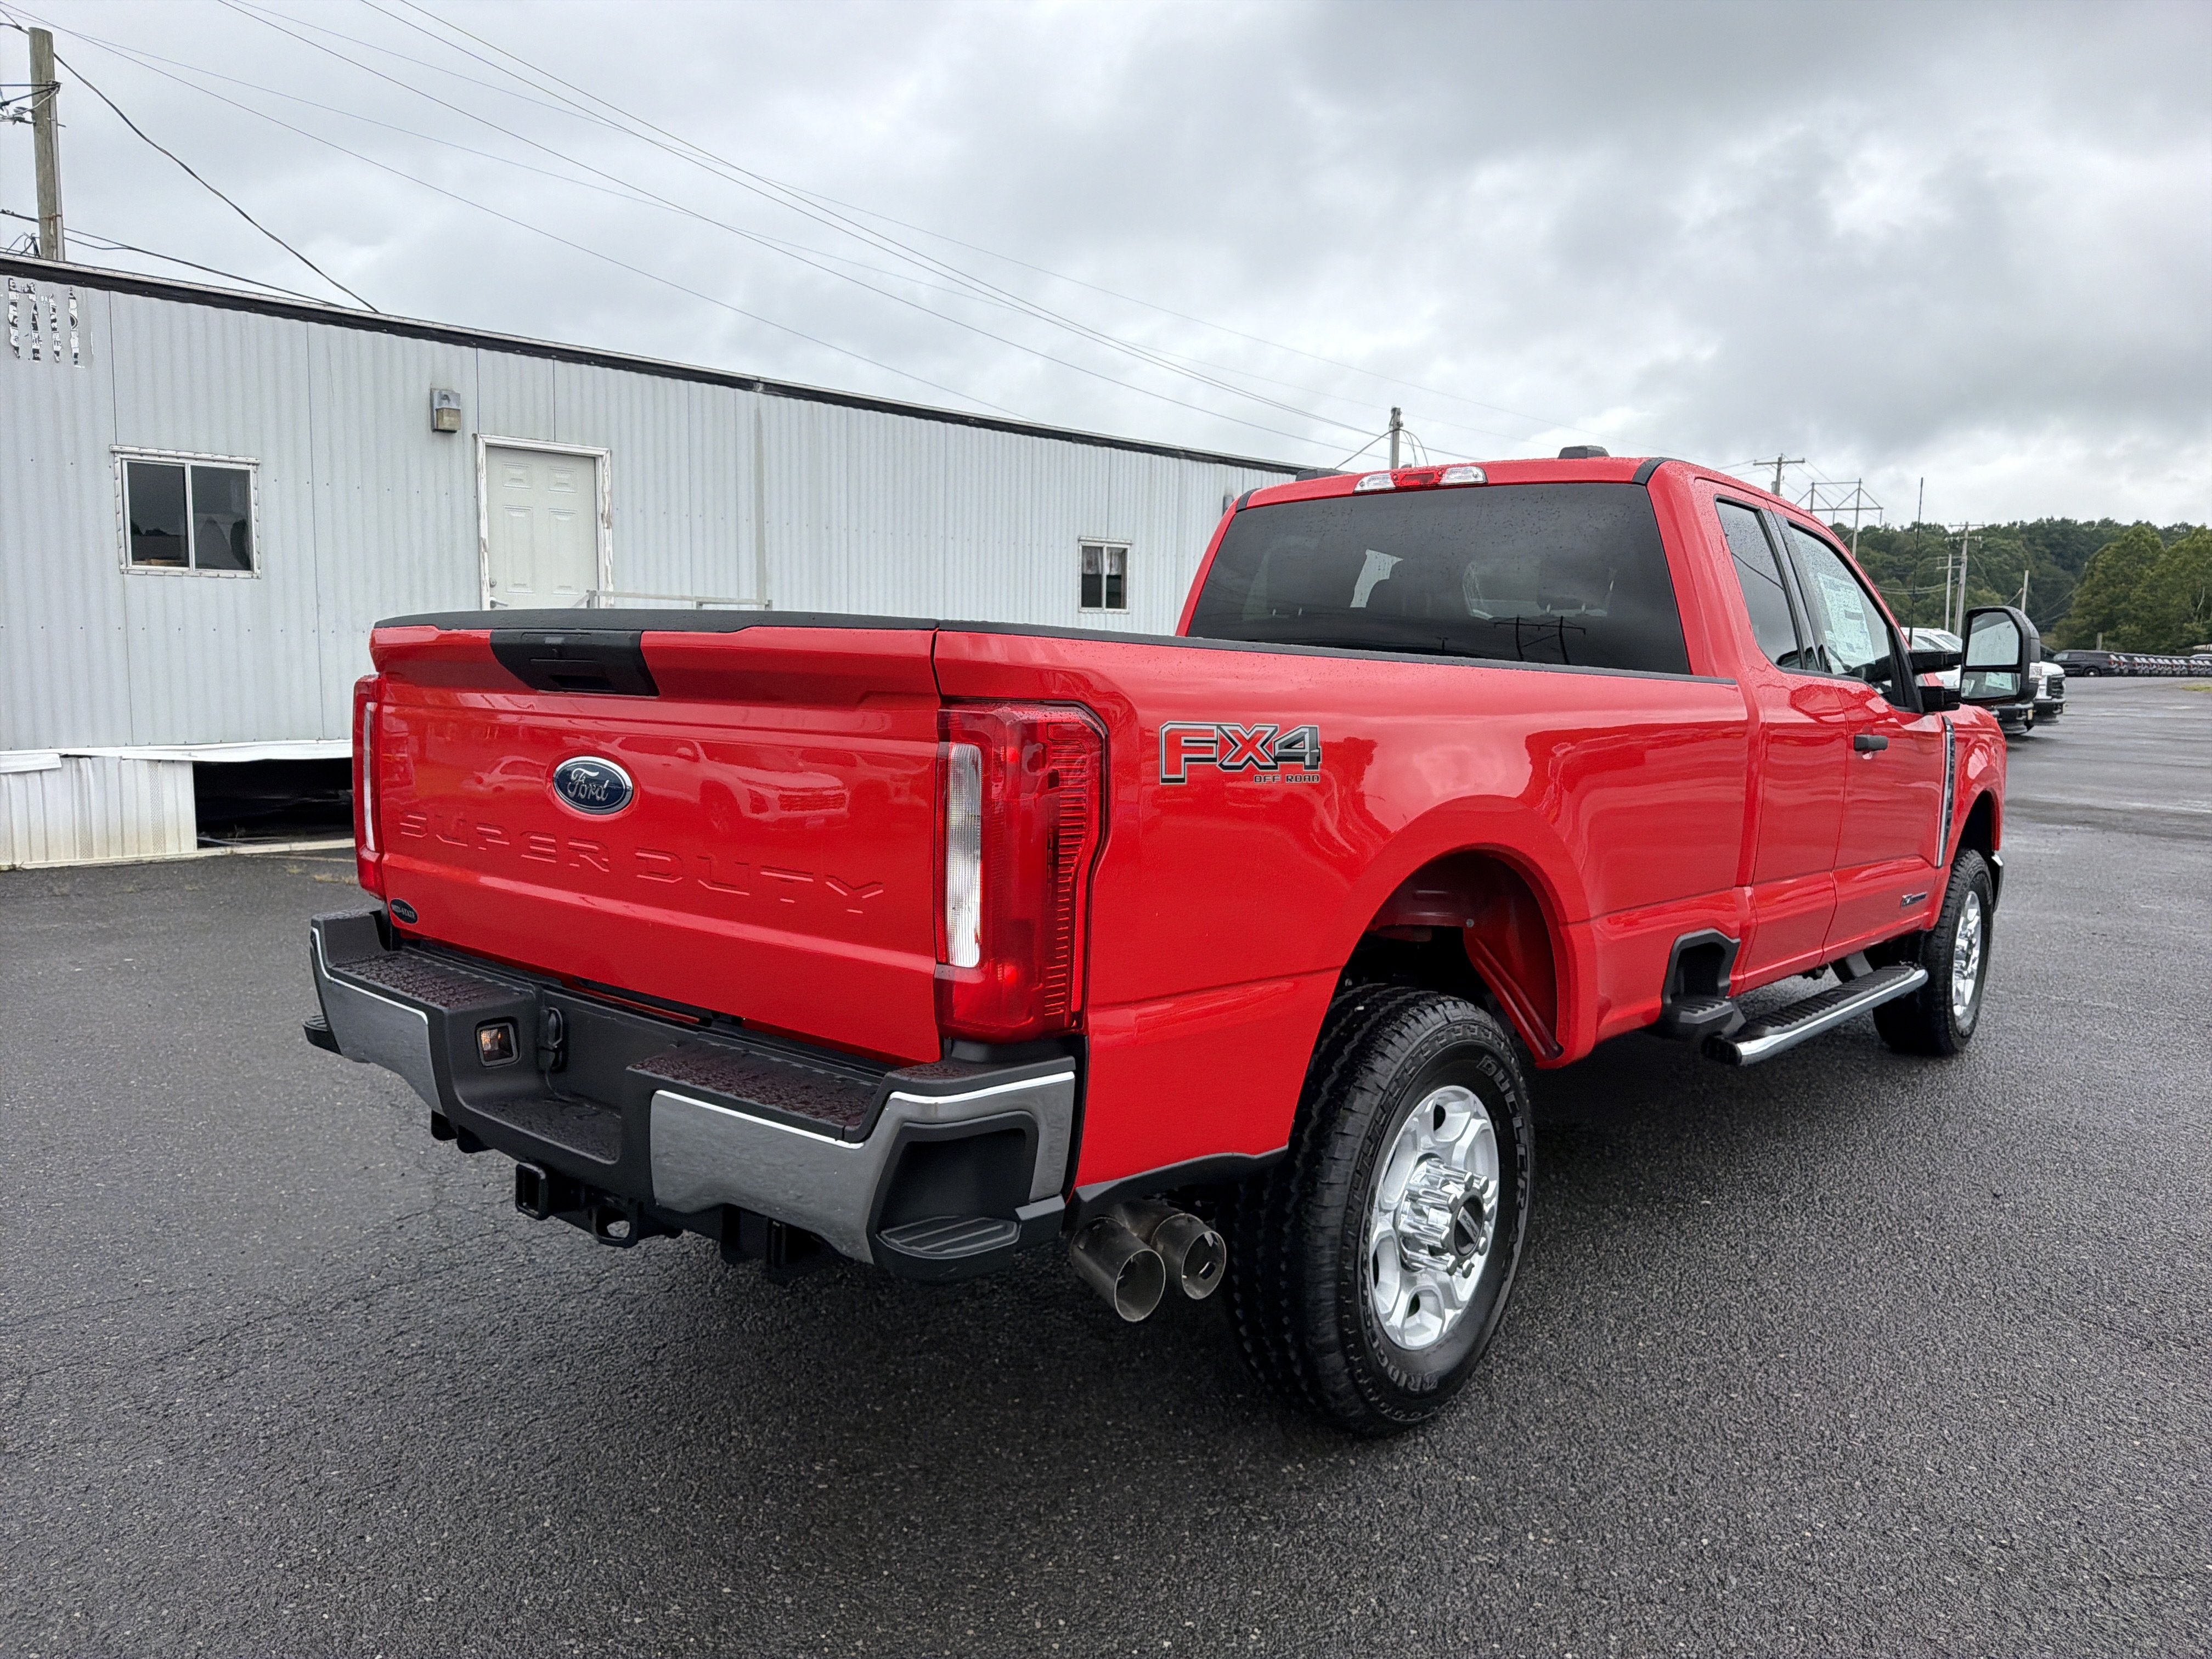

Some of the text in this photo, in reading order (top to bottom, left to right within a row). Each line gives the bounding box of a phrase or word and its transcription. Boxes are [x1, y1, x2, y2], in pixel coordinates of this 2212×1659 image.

[1159, 721, 1322, 785] FX4
[567, 768, 610, 802] Ford
[1254, 774, 1320, 783] OFF ROAD
[399, 812, 884, 914] SUPER DUTY
